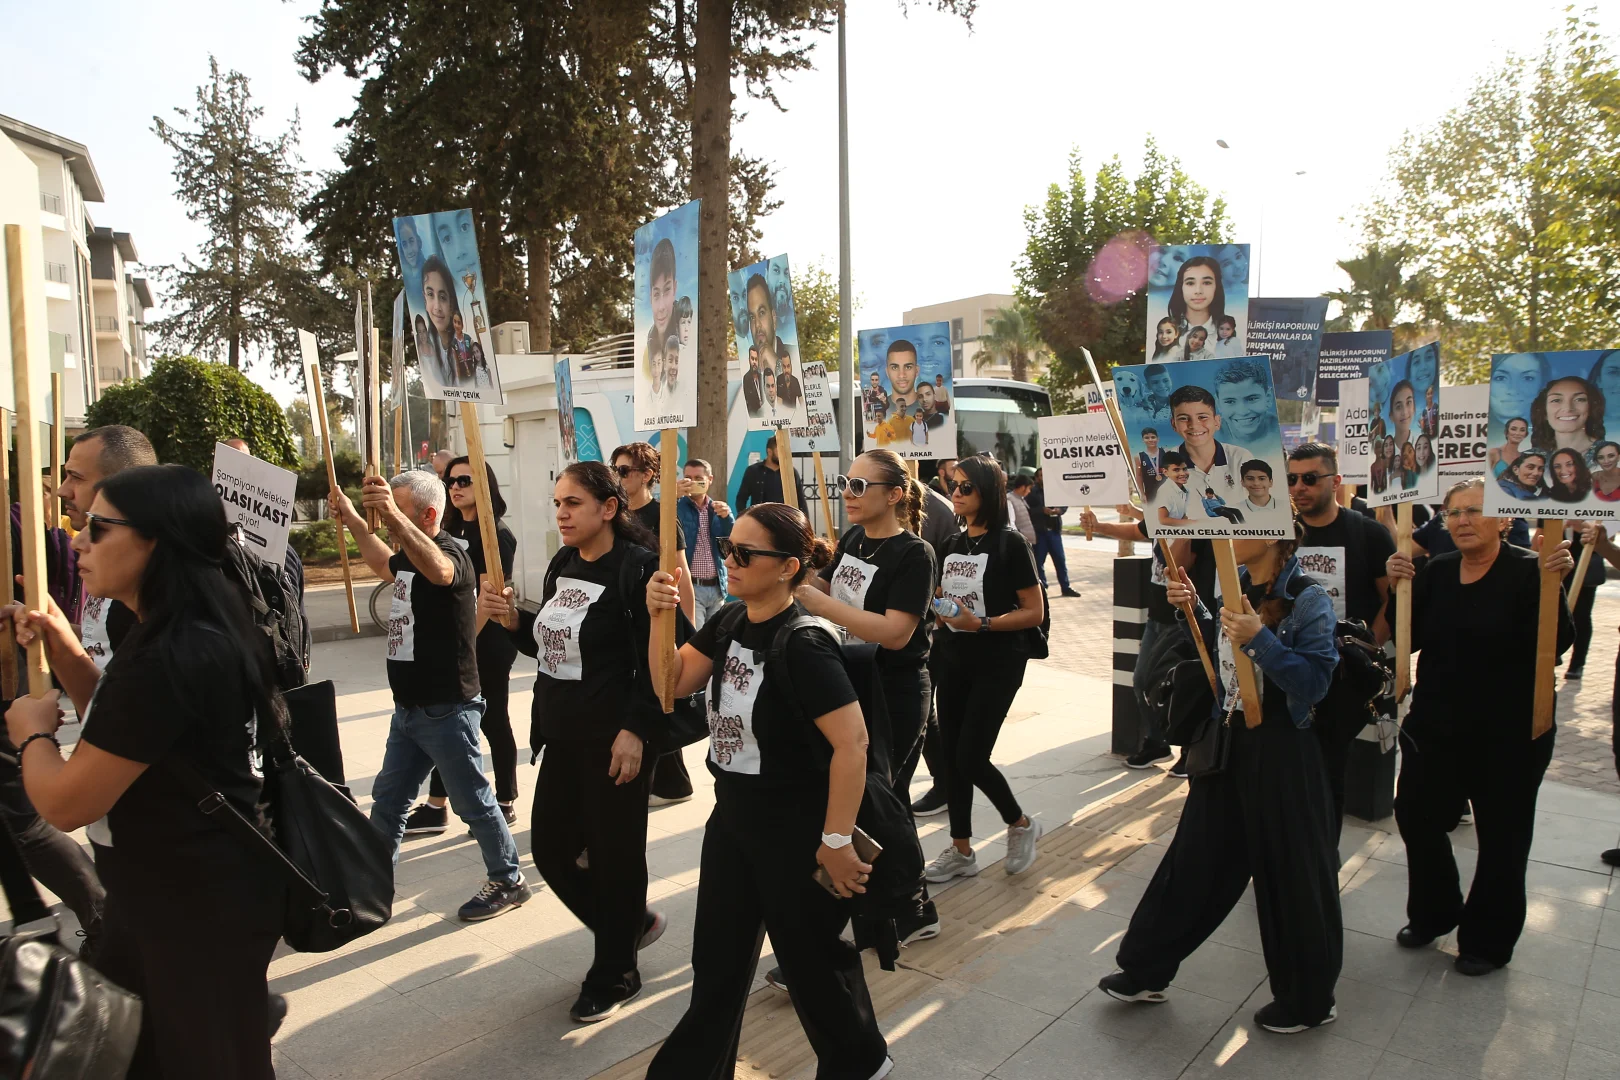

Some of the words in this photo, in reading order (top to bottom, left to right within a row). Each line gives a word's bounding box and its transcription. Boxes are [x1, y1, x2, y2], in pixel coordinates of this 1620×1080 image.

[1247, 320, 1275, 331] İLİRKİŞİ
[1275, 322, 1320, 331] RAPORUNU
[1246, 332, 1300, 340] AZIRLAYANLAR
[1301, 333, 1313, 341] DA
[1320, 348, 1348, 357] BİLİRKİŞİ
[1345, 407, 1368, 420] Ada
[1439, 411, 1473, 420] tillerin
[644, 417, 655, 425] ARAS
[1345, 425, 1368, 437] OLA
[1440, 423, 1472, 438] ASI
[1476, 423, 1488, 438] K
[1042, 435, 1084, 447] Şampiyon
[1085, 432, 1117, 442] Melekle
[1043, 447, 1083, 460] OLASI
[1085, 444, 1121, 457] KAST
[1360, 443, 1368, 455] G
[1438, 442, 1487, 459] EREC
[1071, 460, 1095, 470] diyor!
[216, 469, 256, 494] Şampiyon
[257, 486, 290, 508] Melekler
[1382, 493, 1398, 502] ELVİN
[1399, 489, 1419, 500] ÇAVDIR
[214, 483, 252, 511] OLASI
[252, 499, 289, 527] KAST
[1498, 507, 1532, 515] HAVVA
[1537, 508, 1568, 516] BALCI
[1574, 509, 1615, 517] ÇAVDIR
[237, 512, 260, 529] diyor!
[1154, 528, 1195, 536] ATAKAN
[1233, 529, 1286, 537] KONUKLU
